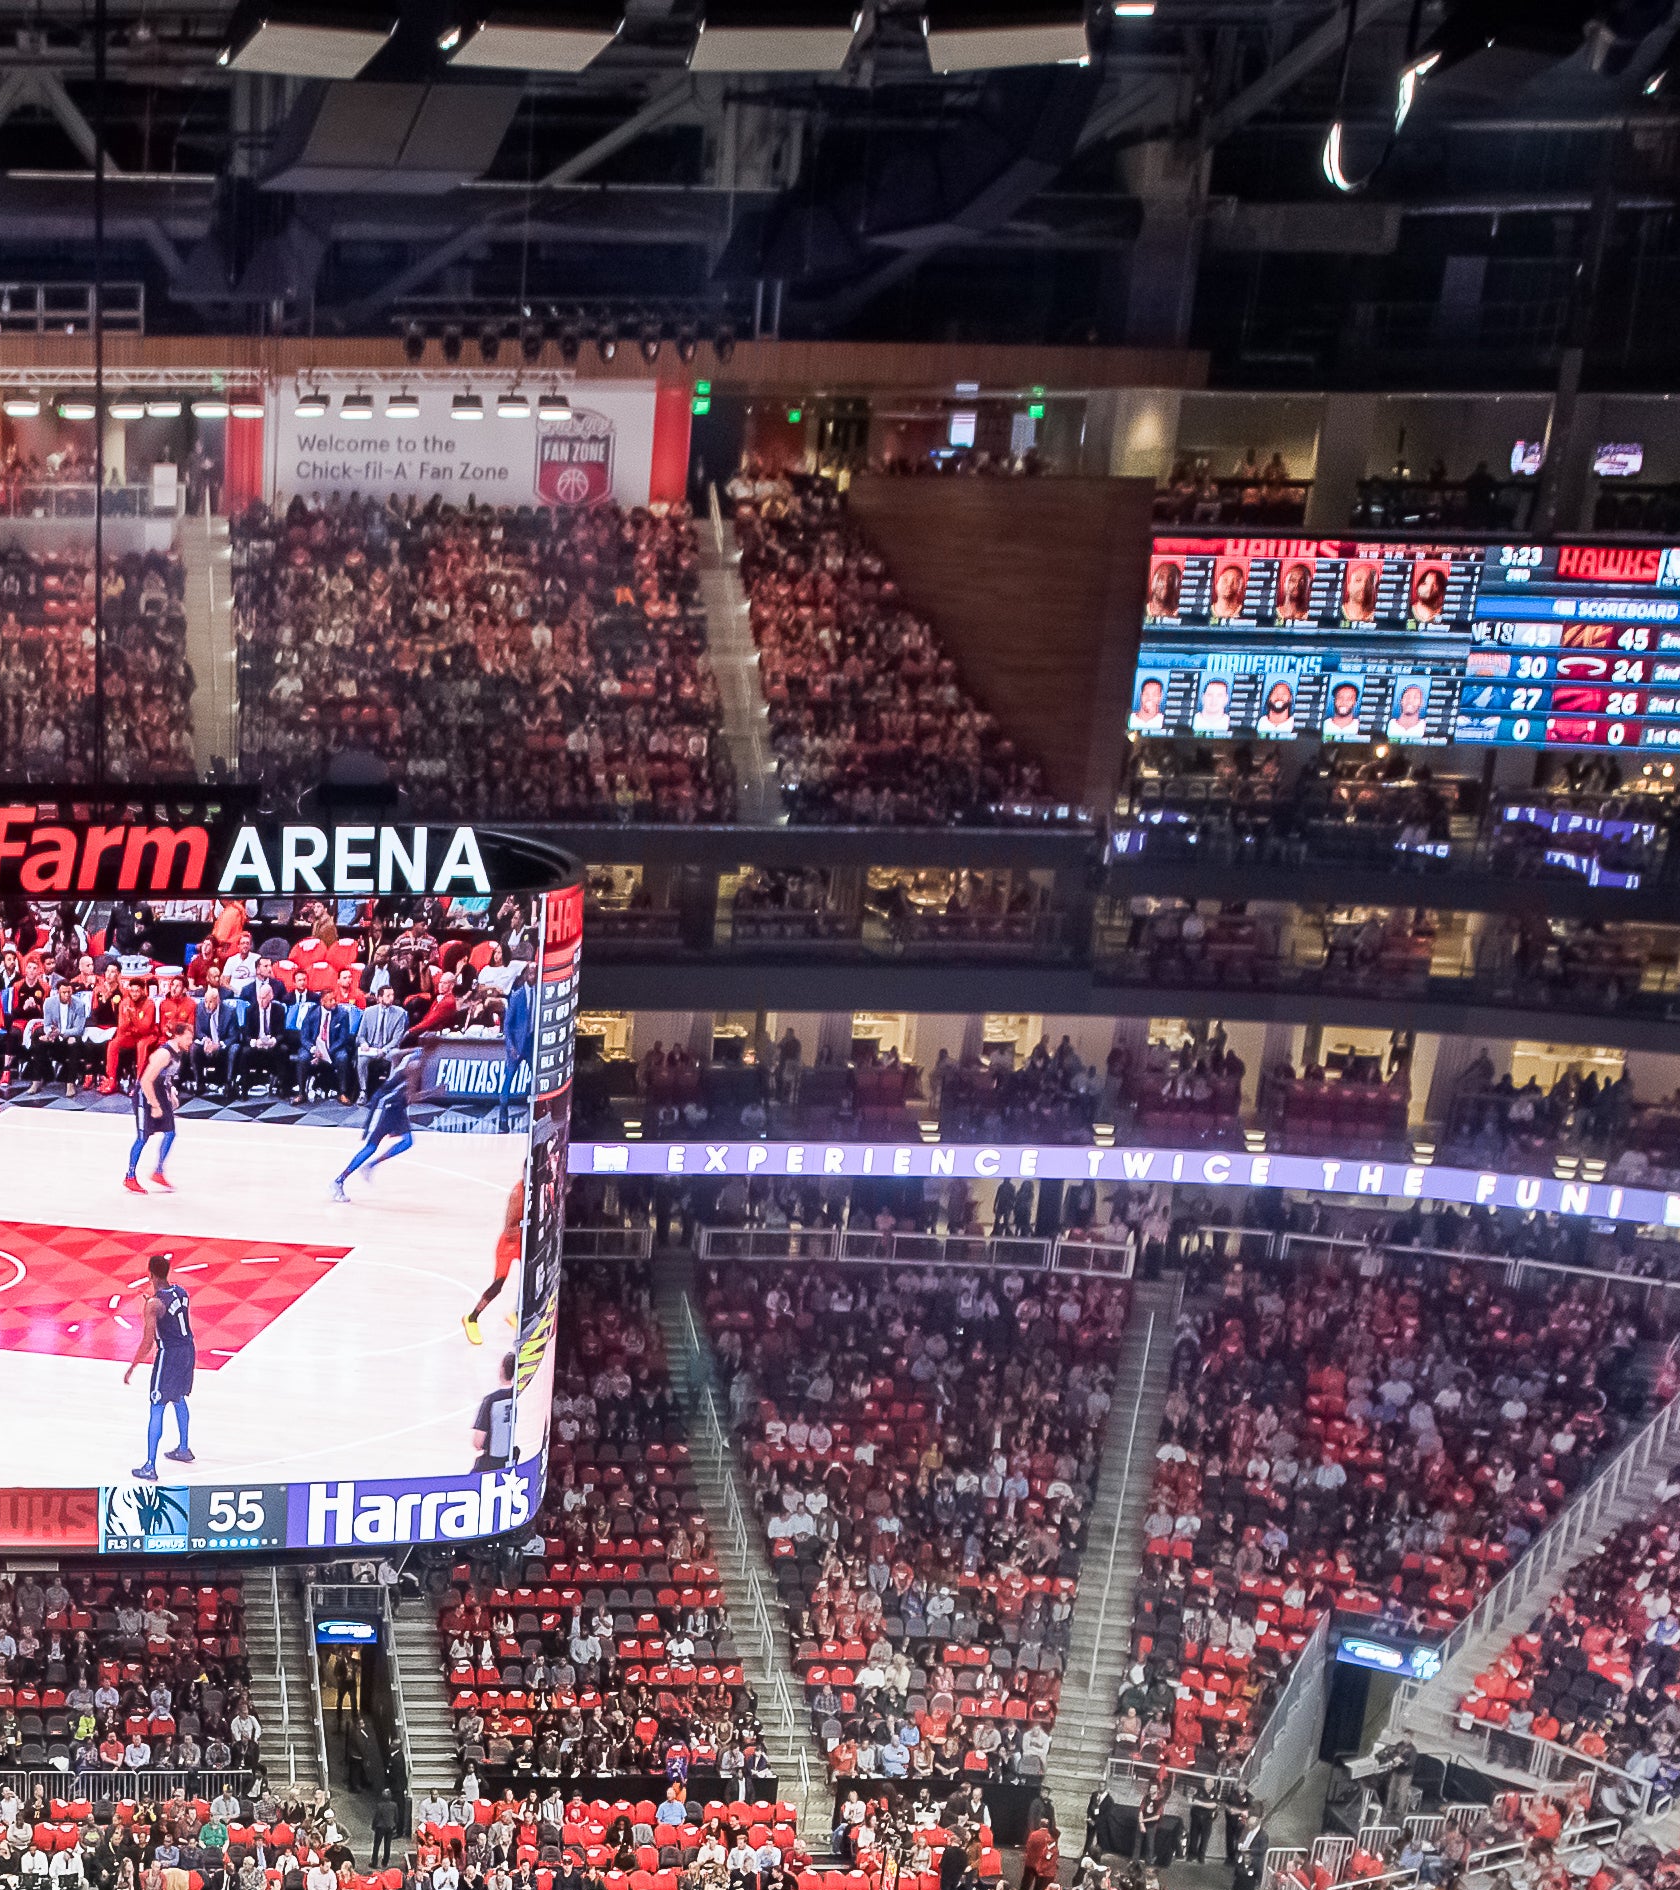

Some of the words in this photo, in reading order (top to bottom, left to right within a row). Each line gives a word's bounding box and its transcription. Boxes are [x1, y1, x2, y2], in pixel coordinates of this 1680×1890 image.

[297, 434, 389, 453] Welcome
[397, 436, 421, 453] to
[424, 434, 456, 453] the
[544, 441, 569, 461] FAN
[572, 441, 606, 462] ZONE
[420, 462, 453, 480] Fan
[459, 462, 508, 480] Zone
[1500, 546, 1543, 567] 3:23
[1558, 547, 1660, 578] HAWKS
[1578, 602, 1679, 620] SCOREBOARD
[1617, 628, 1650, 651] 45
[1515, 655, 1547, 679] 30
[1612, 660, 1644, 683] 24
[1509, 687, 1542, 711] 27
[1605, 692, 1638, 716] 26
[1512, 718, 1531, 742] 0
[1607, 722, 1625, 746] 0
[218, 826, 492, 895] ARENA
[437, 1058, 507, 1094] FANTASY
[666, 1145, 1039, 1178] EXPERIENCE
[1087, 1150, 1272, 1185] TWICE
[1322, 1162, 1426, 1197] THE
[178, 1312, 188, 1337] 1
[207, 1490, 265, 1533] 55
[107, 1538, 128, 1550] FLS
[132, 1538, 141, 1550] 4
[147, 1538, 186, 1550] BONUS
[191, 1537, 207, 1549] TO
